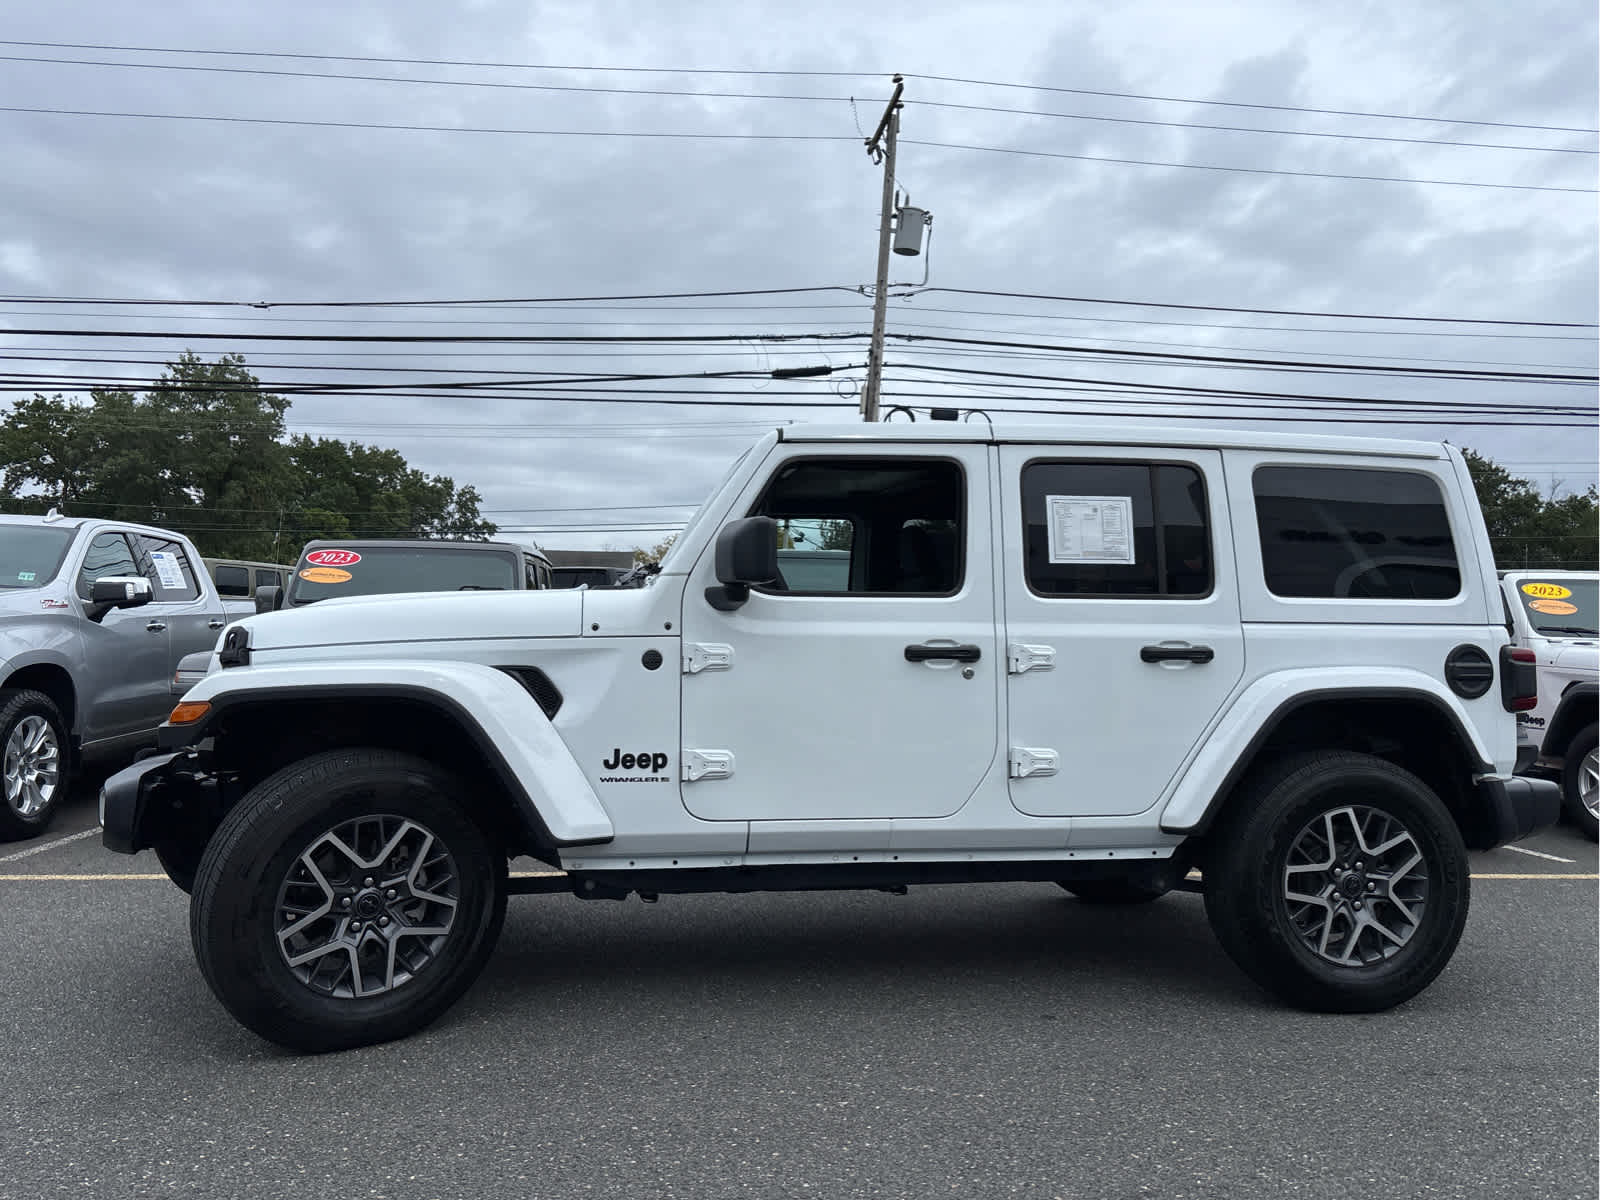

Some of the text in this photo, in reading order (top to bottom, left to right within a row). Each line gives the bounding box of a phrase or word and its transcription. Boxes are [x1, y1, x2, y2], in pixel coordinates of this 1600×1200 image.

[313, 552, 354, 563] 2023
[1531, 585, 1563, 597] 2023
[603, 748, 668, 773] Jeep
